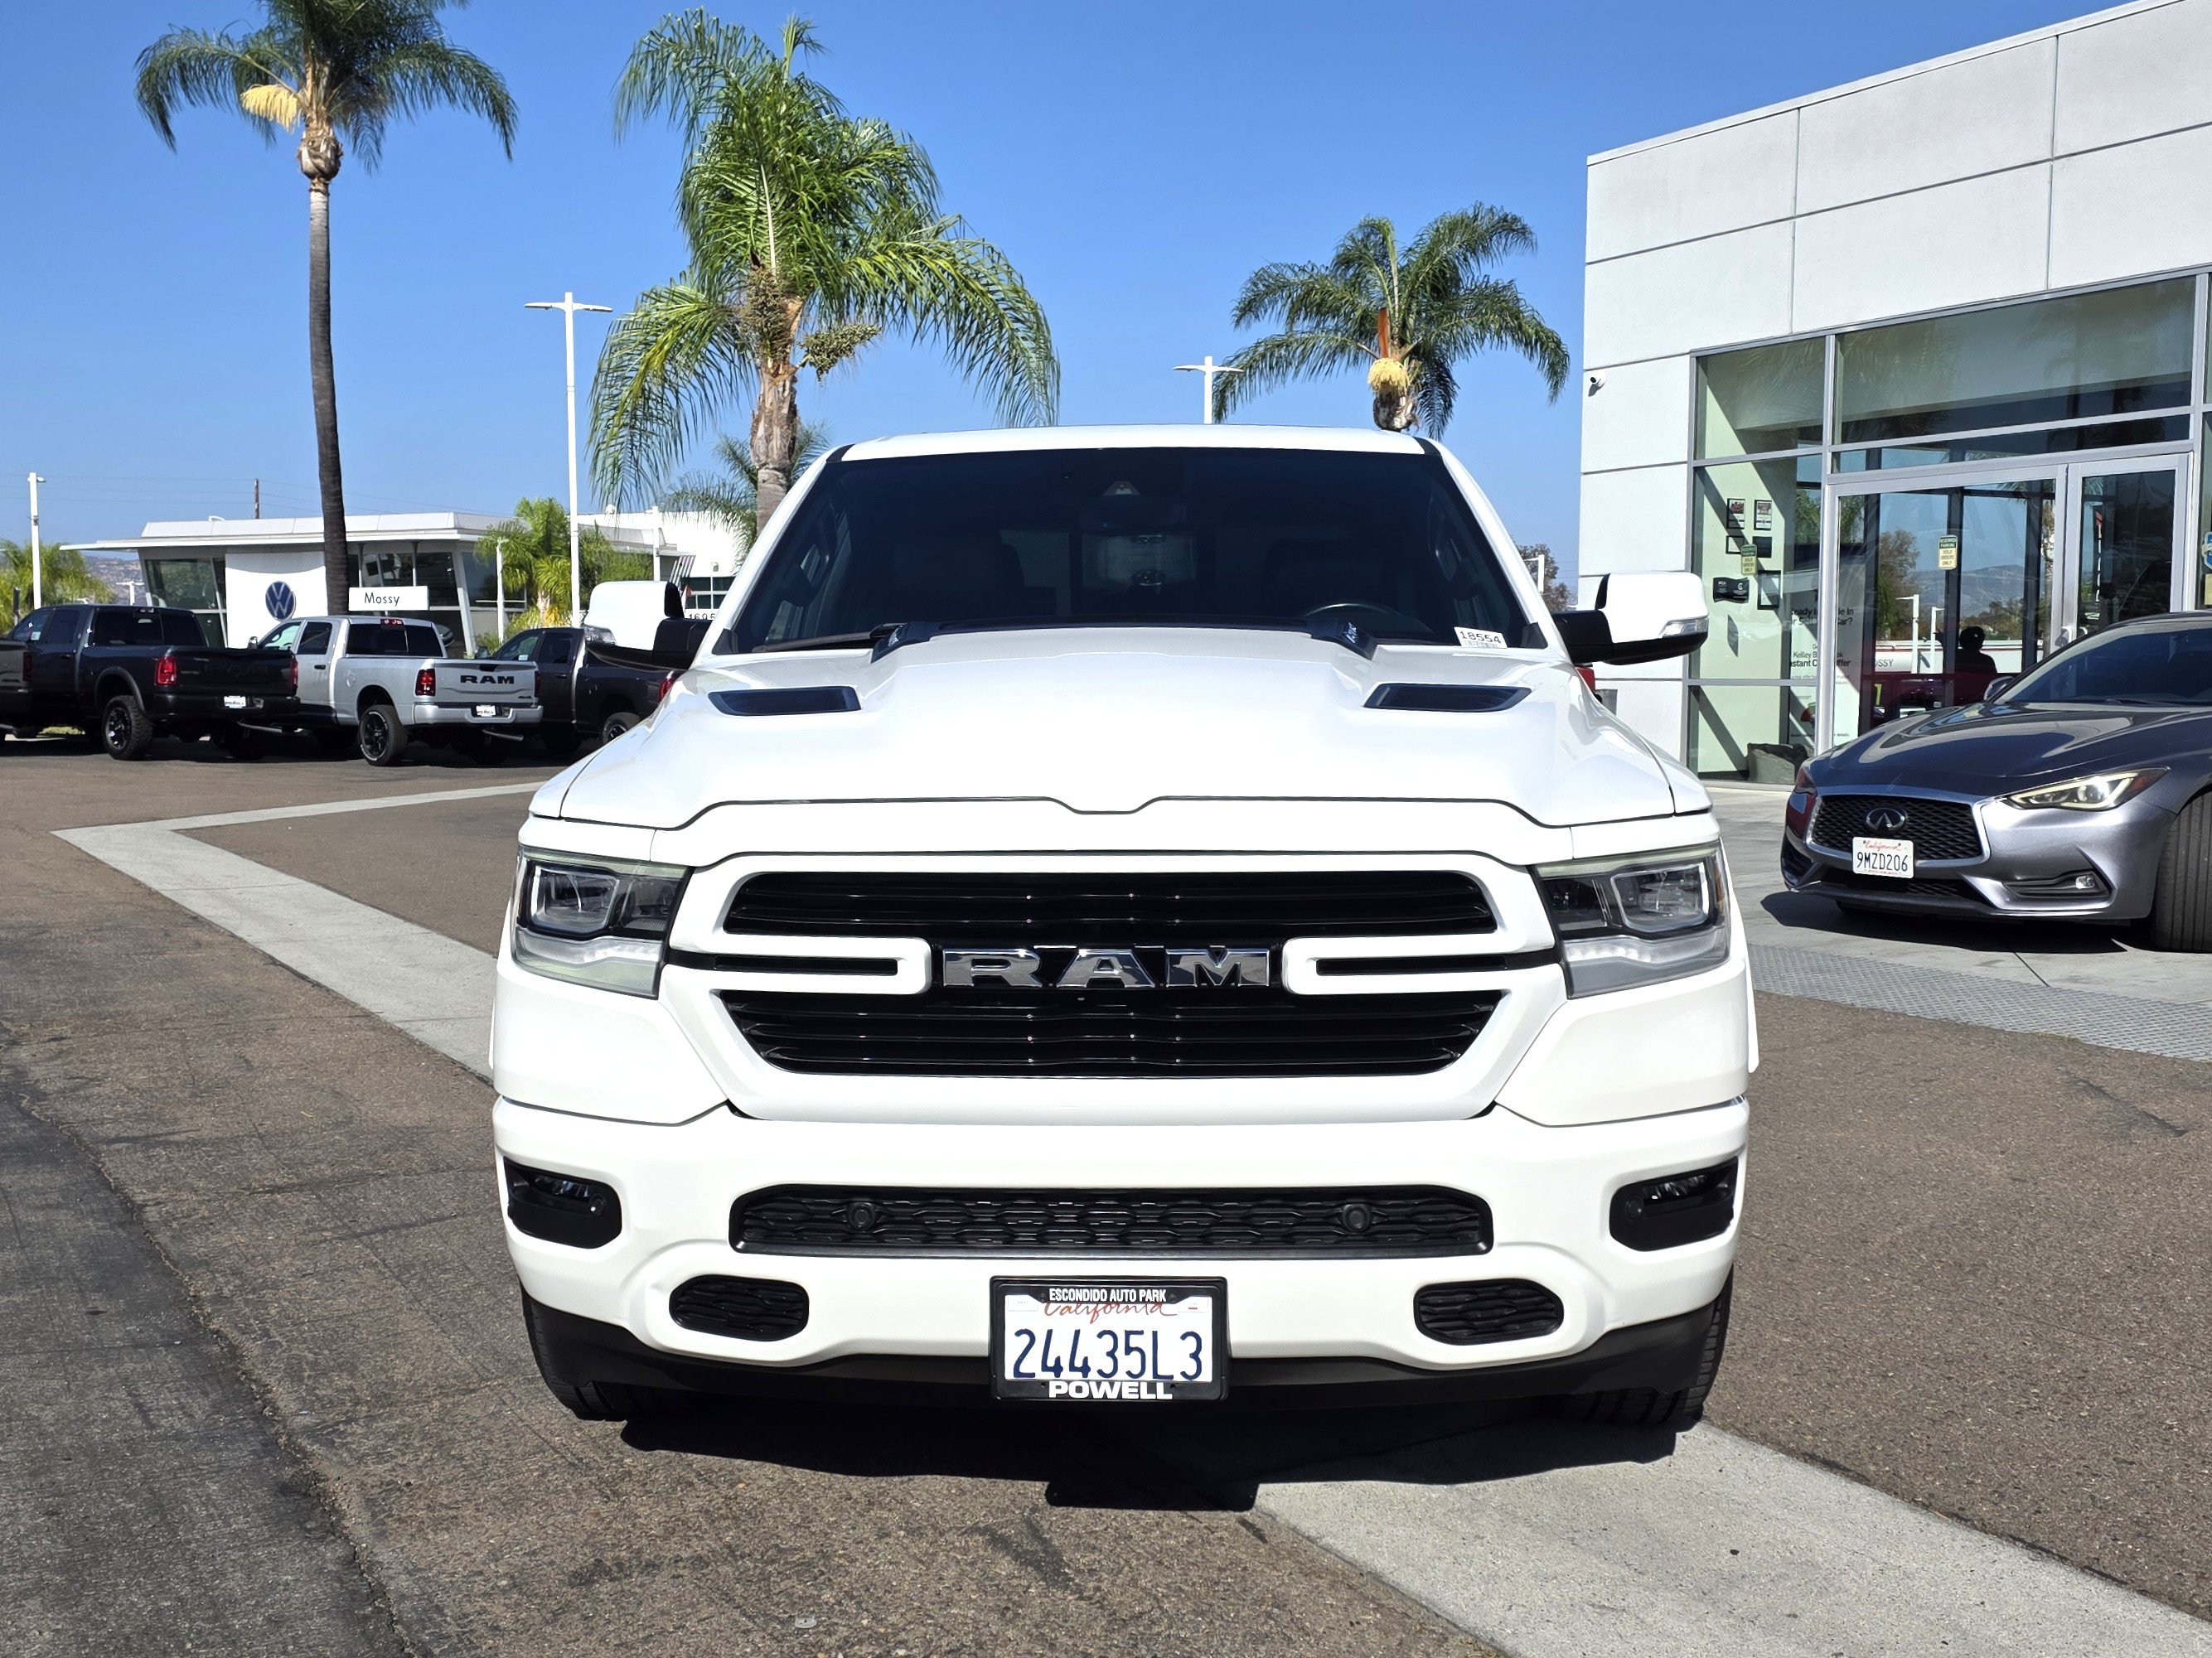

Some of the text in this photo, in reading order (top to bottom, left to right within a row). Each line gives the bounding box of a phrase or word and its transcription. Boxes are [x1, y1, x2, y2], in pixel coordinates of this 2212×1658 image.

[364, 592, 400, 607] Mossy
[1459, 631, 1502, 644] 18554
[1793, 651, 1812, 660] Kelley
[460, 674, 515, 684] RAM
[1865, 840, 1902, 852] California
[1856, 852, 1908, 872] 9MZD206
[942, 948, 1270, 988] RAM
[1049, 1288, 1167, 1303] ESCONDIDO AUTO PARK
[1043, 1301, 1179, 1325] California
[1013, 1328, 1203, 1380] 24435L3
[1048, 1380, 1173, 1400] POWELL
